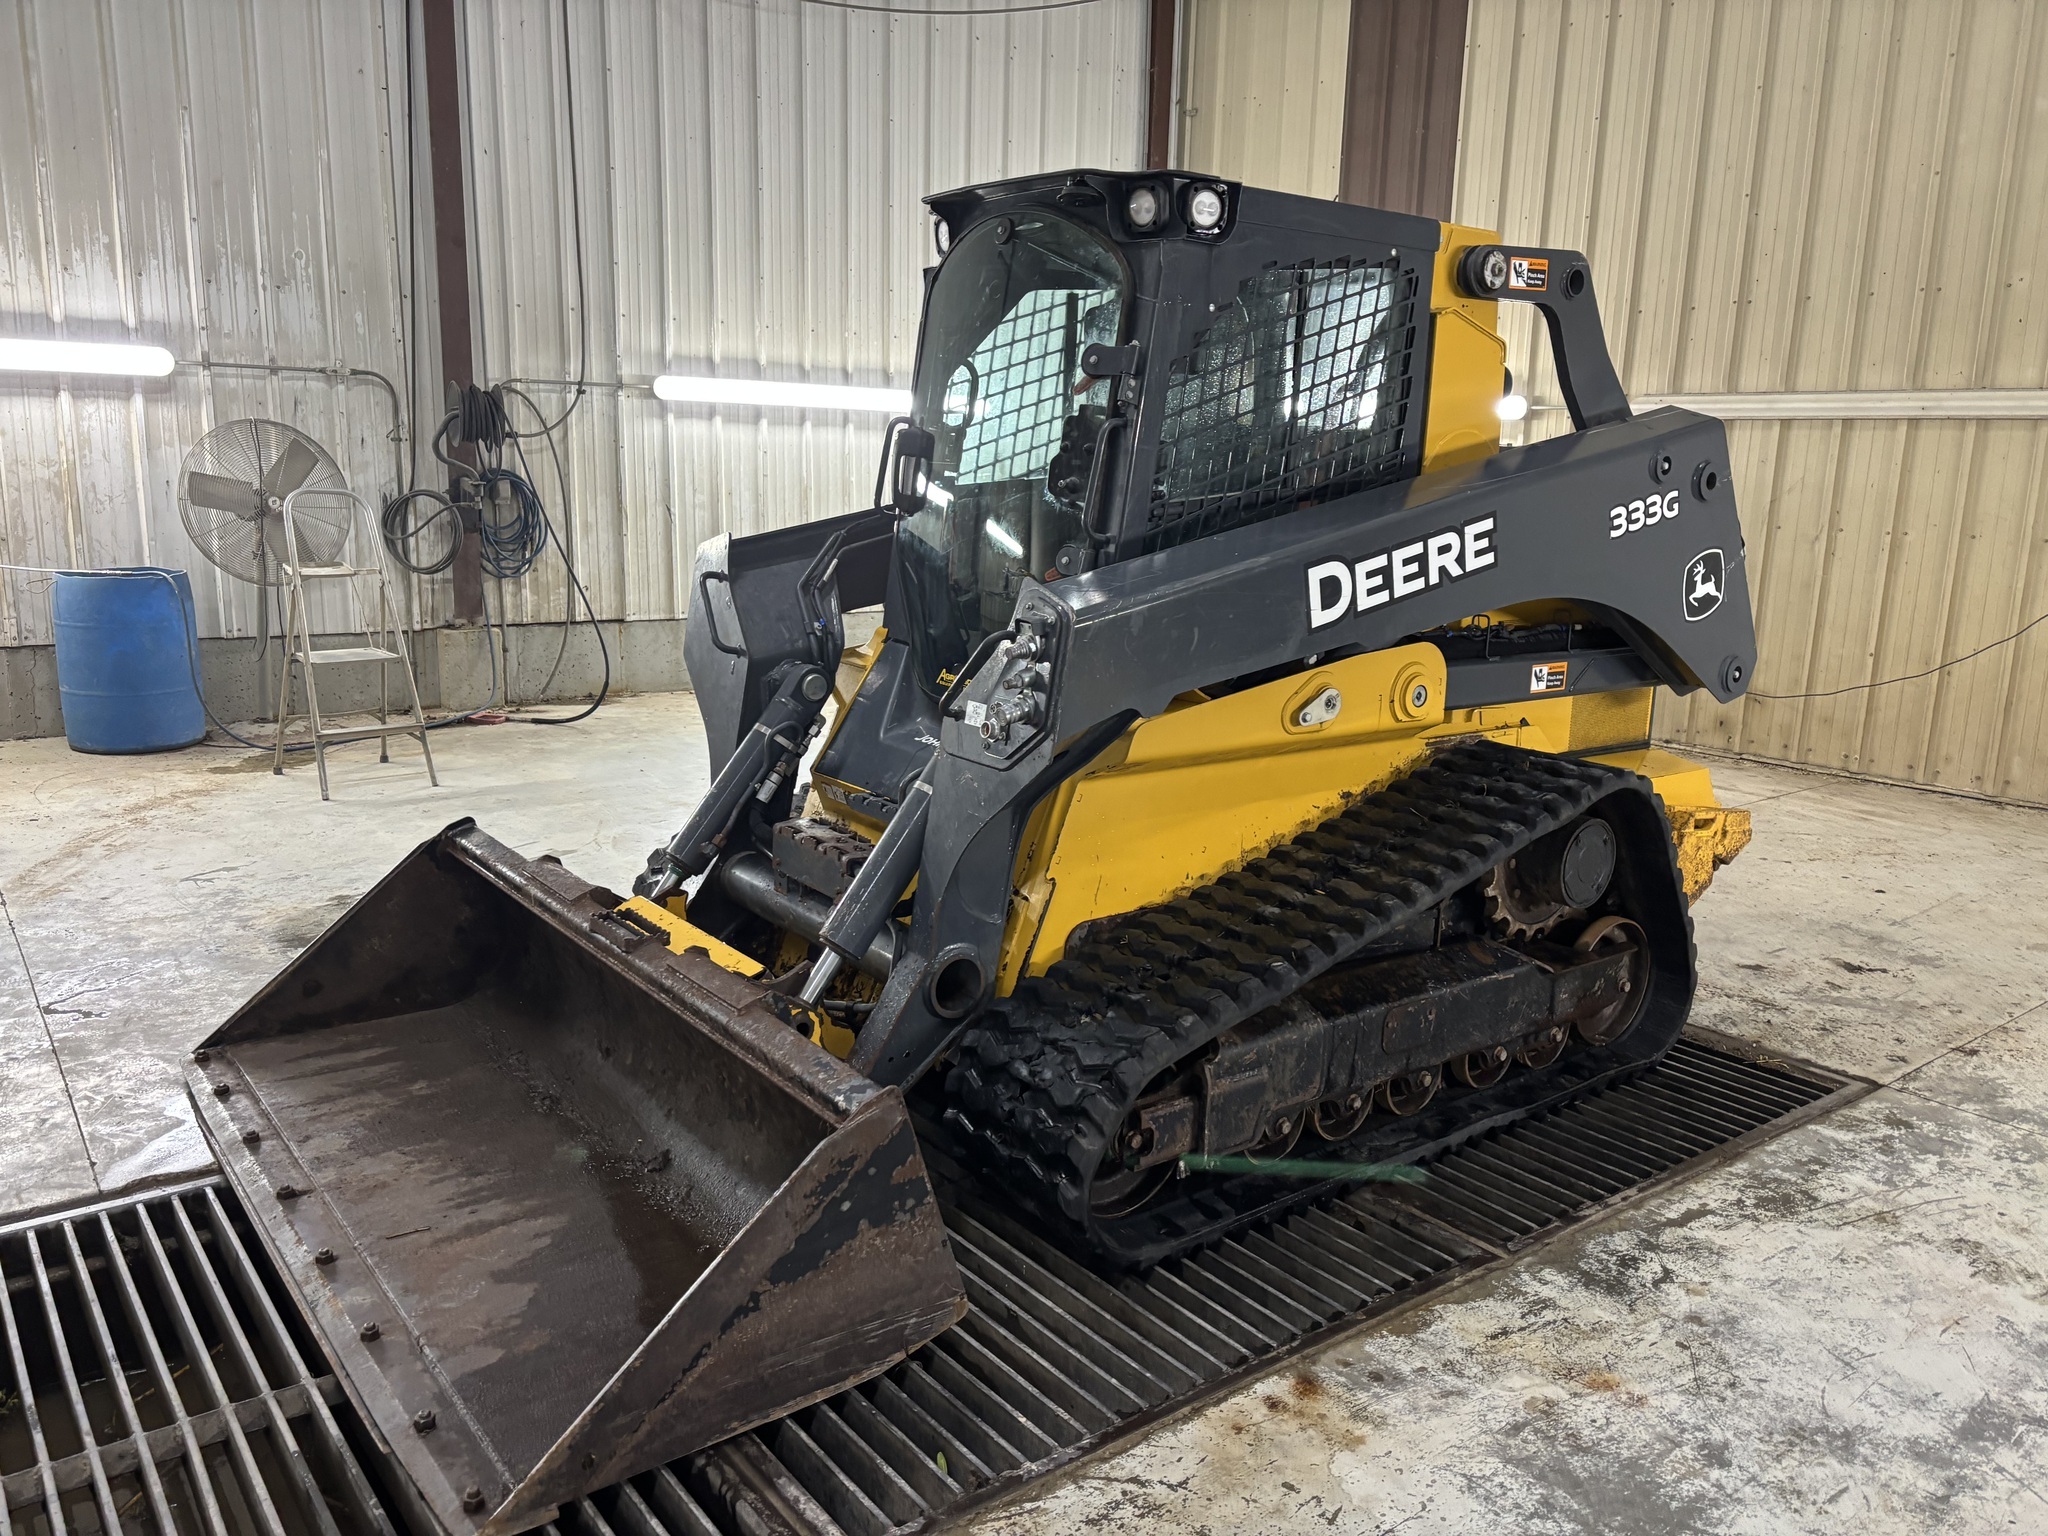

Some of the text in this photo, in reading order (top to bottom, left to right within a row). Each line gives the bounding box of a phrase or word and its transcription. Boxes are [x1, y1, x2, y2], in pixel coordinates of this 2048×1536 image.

[1609, 490, 1679, 538] 333G
[1307, 517, 1495, 629] DEERE
[914, 734, 941, 747] JOH
